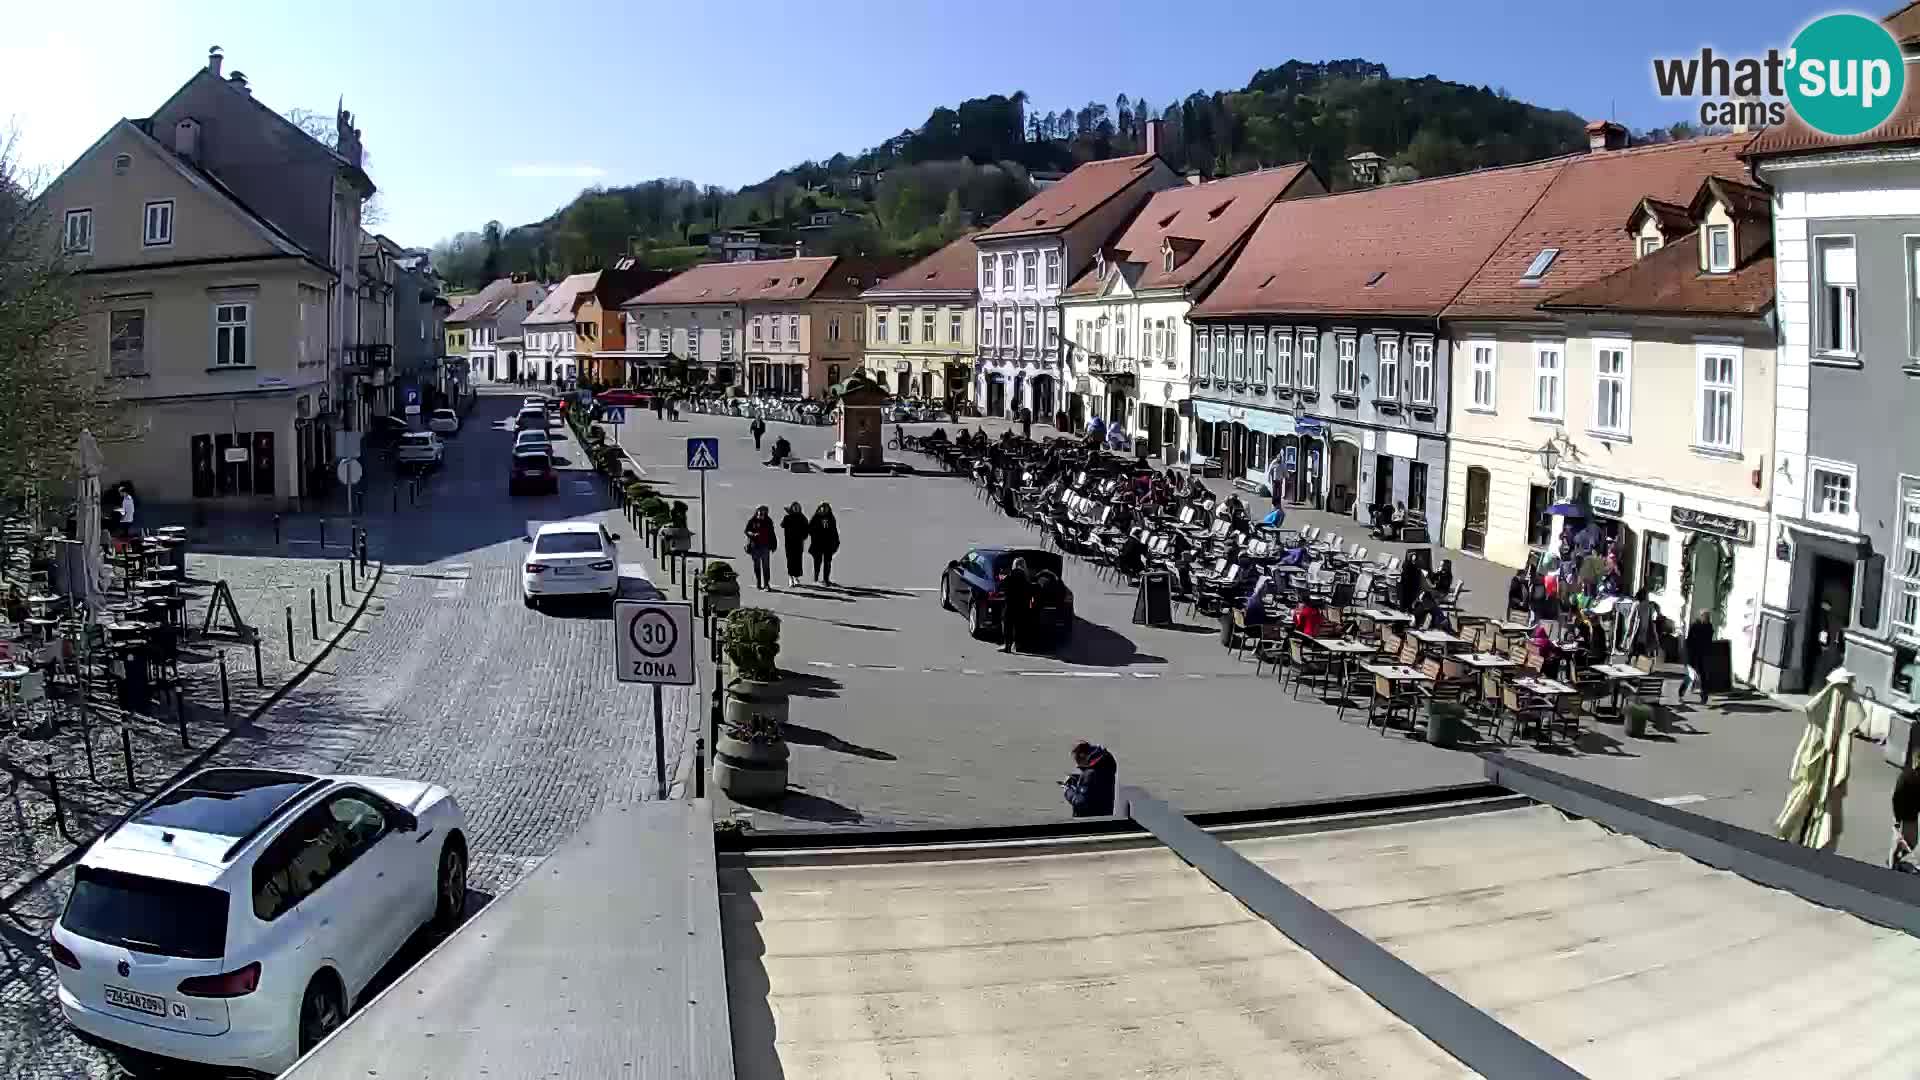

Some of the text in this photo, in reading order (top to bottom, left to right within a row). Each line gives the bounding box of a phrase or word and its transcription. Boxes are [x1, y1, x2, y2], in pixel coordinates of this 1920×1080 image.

[408, 391, 417, 402] P
[642, 623, 666, 645] 30
[632, 661, 677, 677] ZONA
